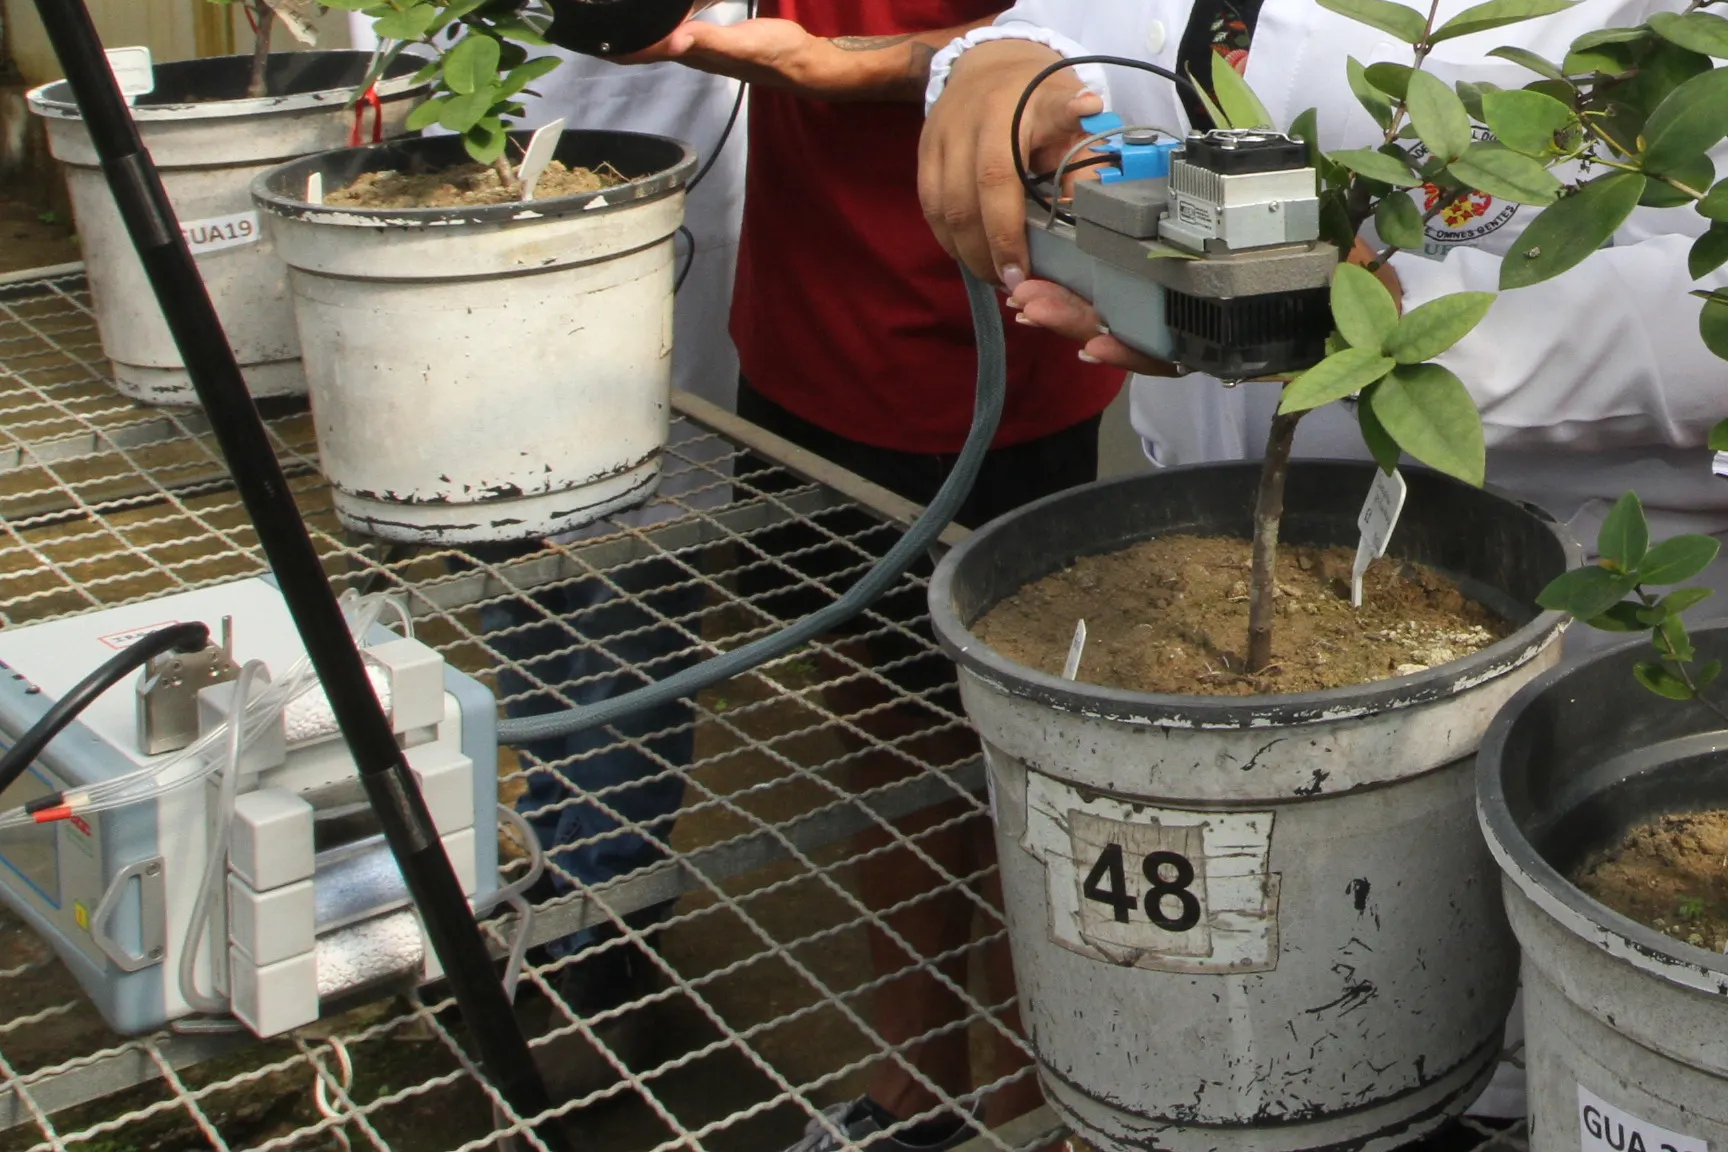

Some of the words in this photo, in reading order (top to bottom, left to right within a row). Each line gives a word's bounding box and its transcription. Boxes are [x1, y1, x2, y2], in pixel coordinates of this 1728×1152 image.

[183, 219, 254, 245] UA19
[1436, 227, 1475, 239] OMNES
[1082, 842, 1201, 933] 48
[1583, 1104, 1647, 1152] GUA
